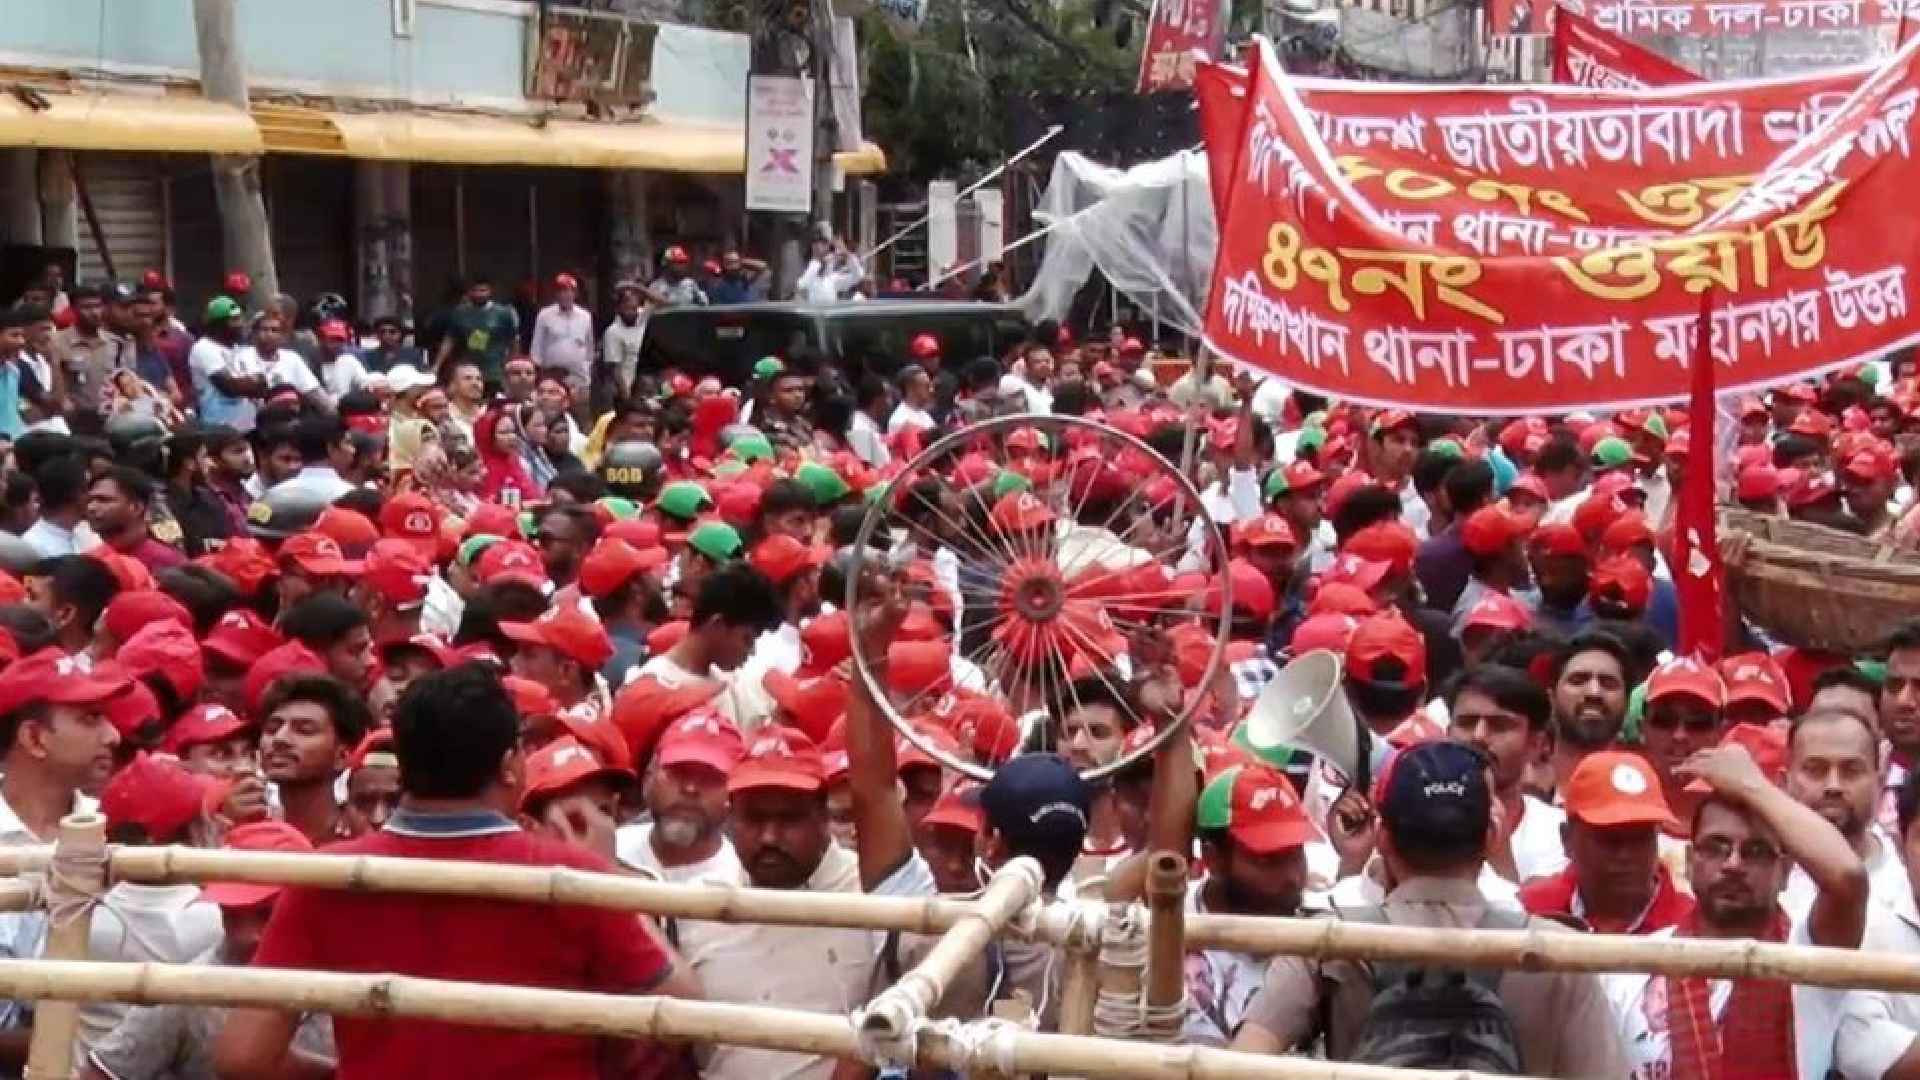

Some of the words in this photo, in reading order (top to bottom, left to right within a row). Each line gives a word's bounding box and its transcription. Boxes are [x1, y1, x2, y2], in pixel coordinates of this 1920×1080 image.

[1263, 222, 1505, 325] ৪৭নং
[1550, 180, 1849, 301] ওয়ার্ড
[1825, 264, 1907, 329] উত্তর
[1423, 781, 1465, 798] POLICE
